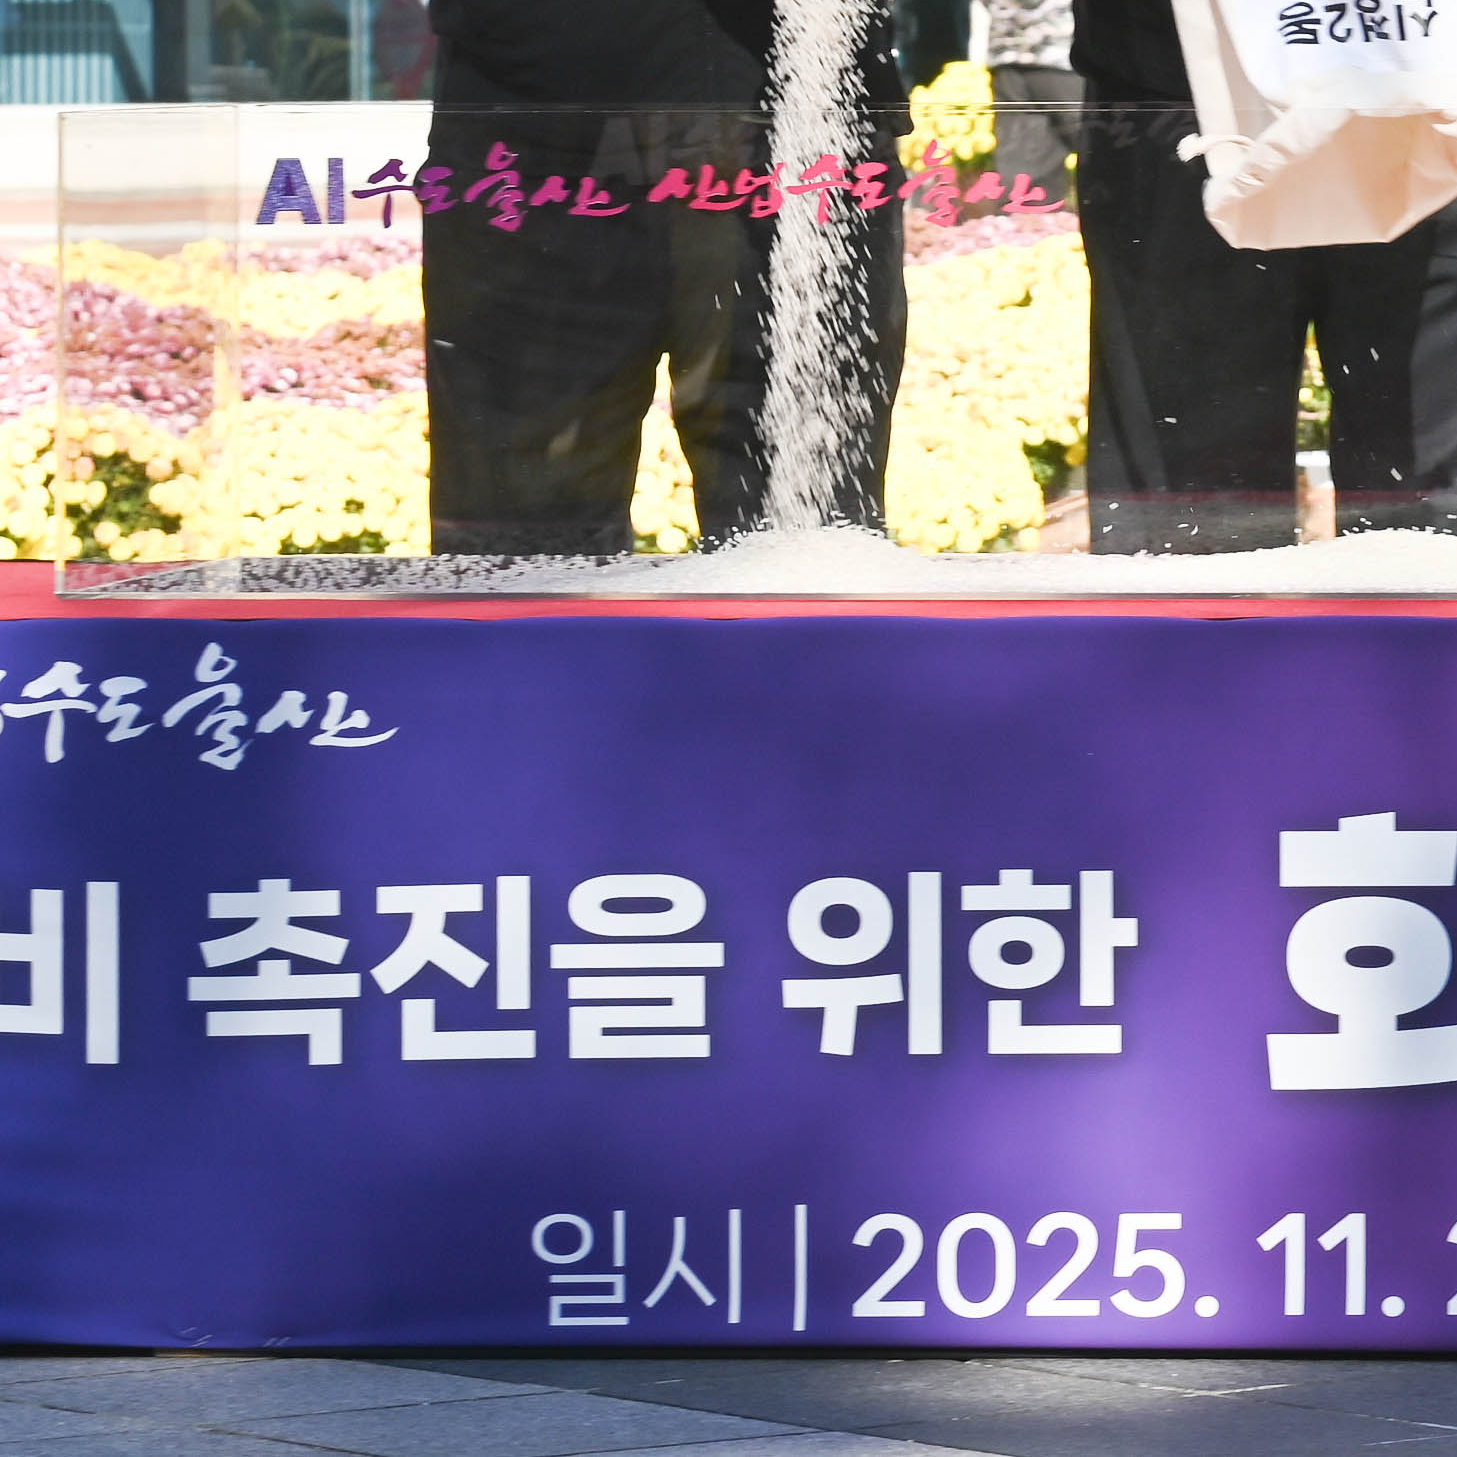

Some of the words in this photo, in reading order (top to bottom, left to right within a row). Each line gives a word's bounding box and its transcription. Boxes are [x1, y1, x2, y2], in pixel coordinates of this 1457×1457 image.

[0, 641, 400, 772] 수도울산
[188, 872, 725, 1067] 촉진을
[781, 869, 1139, 1057] 위한
[532, 1208, 742, 1327] 일시
[852, 1211, 1221, 1320] 2025.
[1256, 1212, 1406, 1318] 11.
